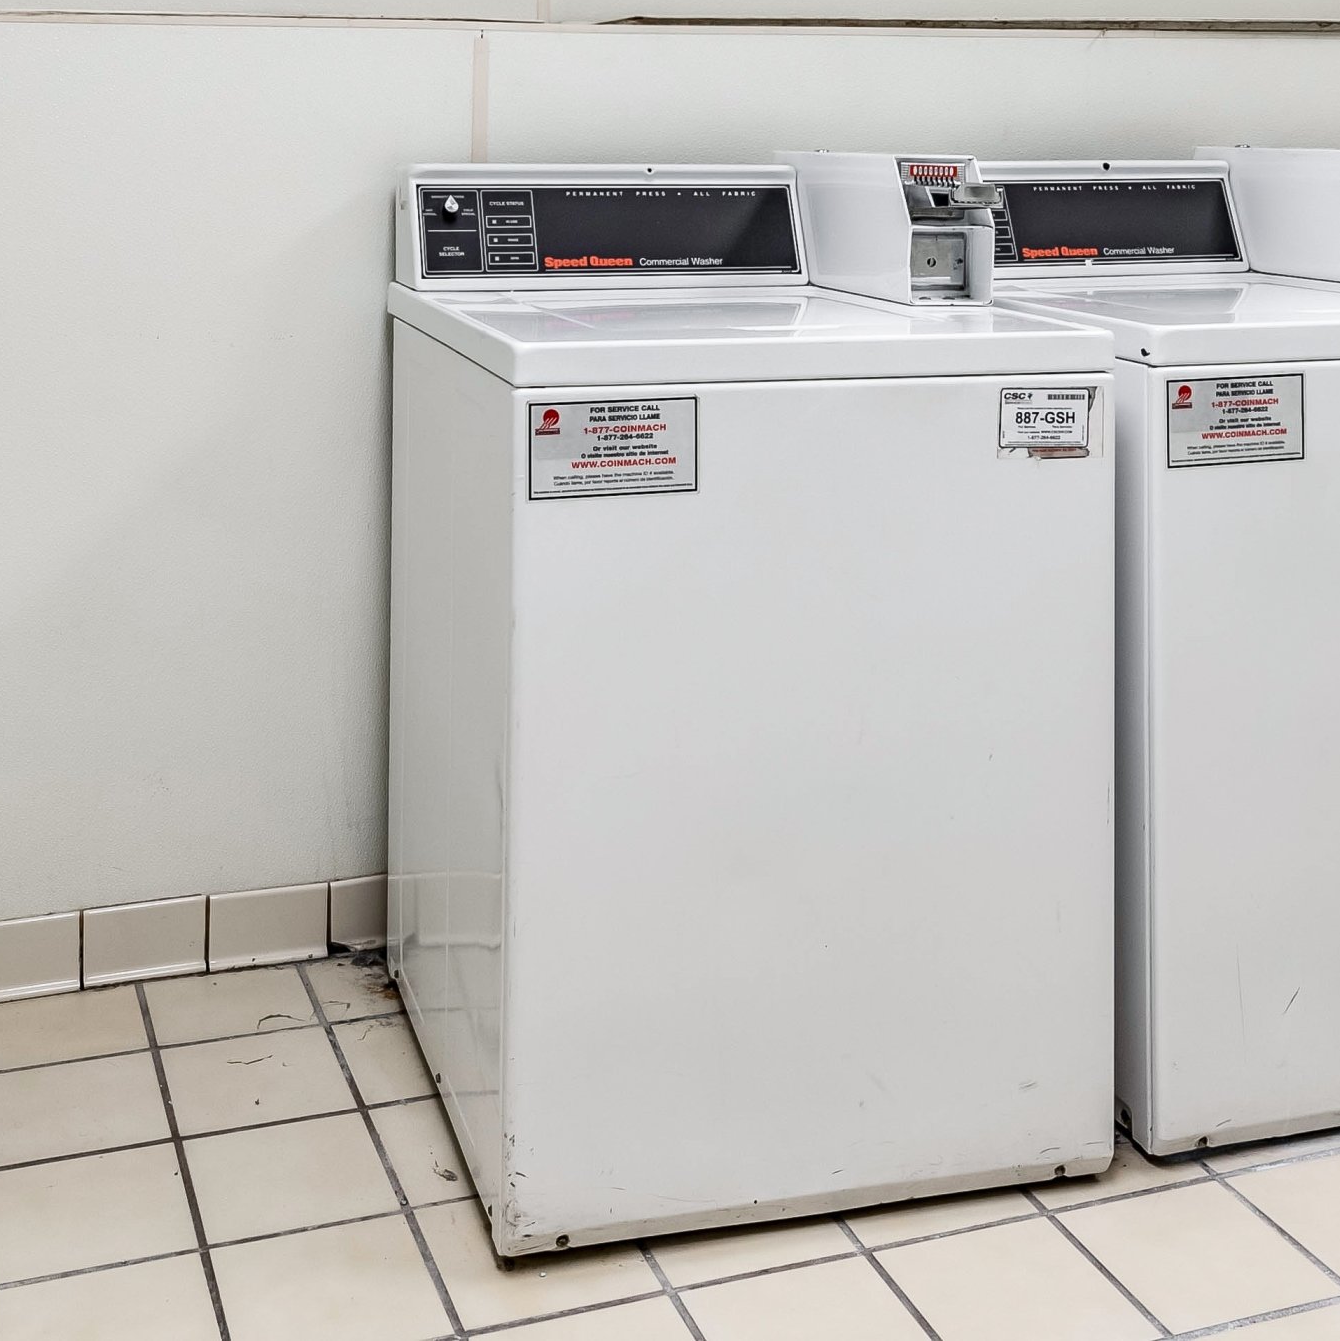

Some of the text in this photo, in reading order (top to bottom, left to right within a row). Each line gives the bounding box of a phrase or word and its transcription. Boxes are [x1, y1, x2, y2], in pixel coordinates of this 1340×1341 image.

[1022, 248, 1059, 258] Speed
[1061, 247, 1098, 256] Queen
[1103, 247, 1146, 255] Commercial
[545, 256, 723, 268] Speed Queen Commercial Washer
[1211, 398, 1278, 408] 1-877-COINMACH
[1016, 412, 1075, 424] 887-GSH
[584, 424, 666, 434] 1-877-COINMACH
[1202, 428, 1287, 439] WWW.COINMACH.COM
[597, 433, 653, 441] 1-877-264-6622
[572, 457, 676, 469] WWW.COINMACH.COM
